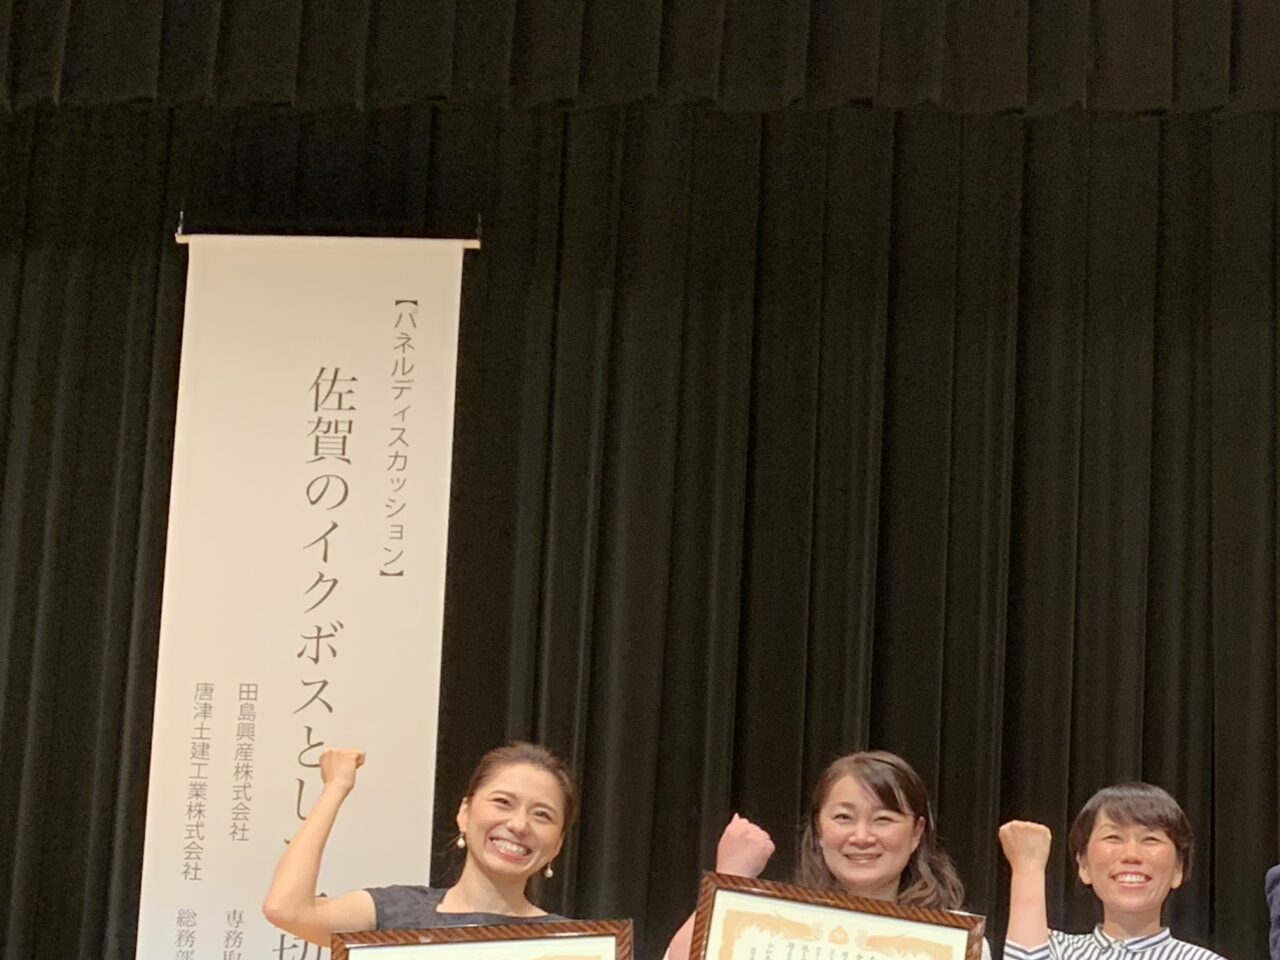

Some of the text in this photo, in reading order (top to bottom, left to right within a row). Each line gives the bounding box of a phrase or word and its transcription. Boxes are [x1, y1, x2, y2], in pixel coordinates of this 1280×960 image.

[380, 298, 419, 578] 【パネルディスカッション】
[182, 682, 215, 881] 唐津土建工業株式会社
[228, 683, 258, 843] 田島興産株式会社
